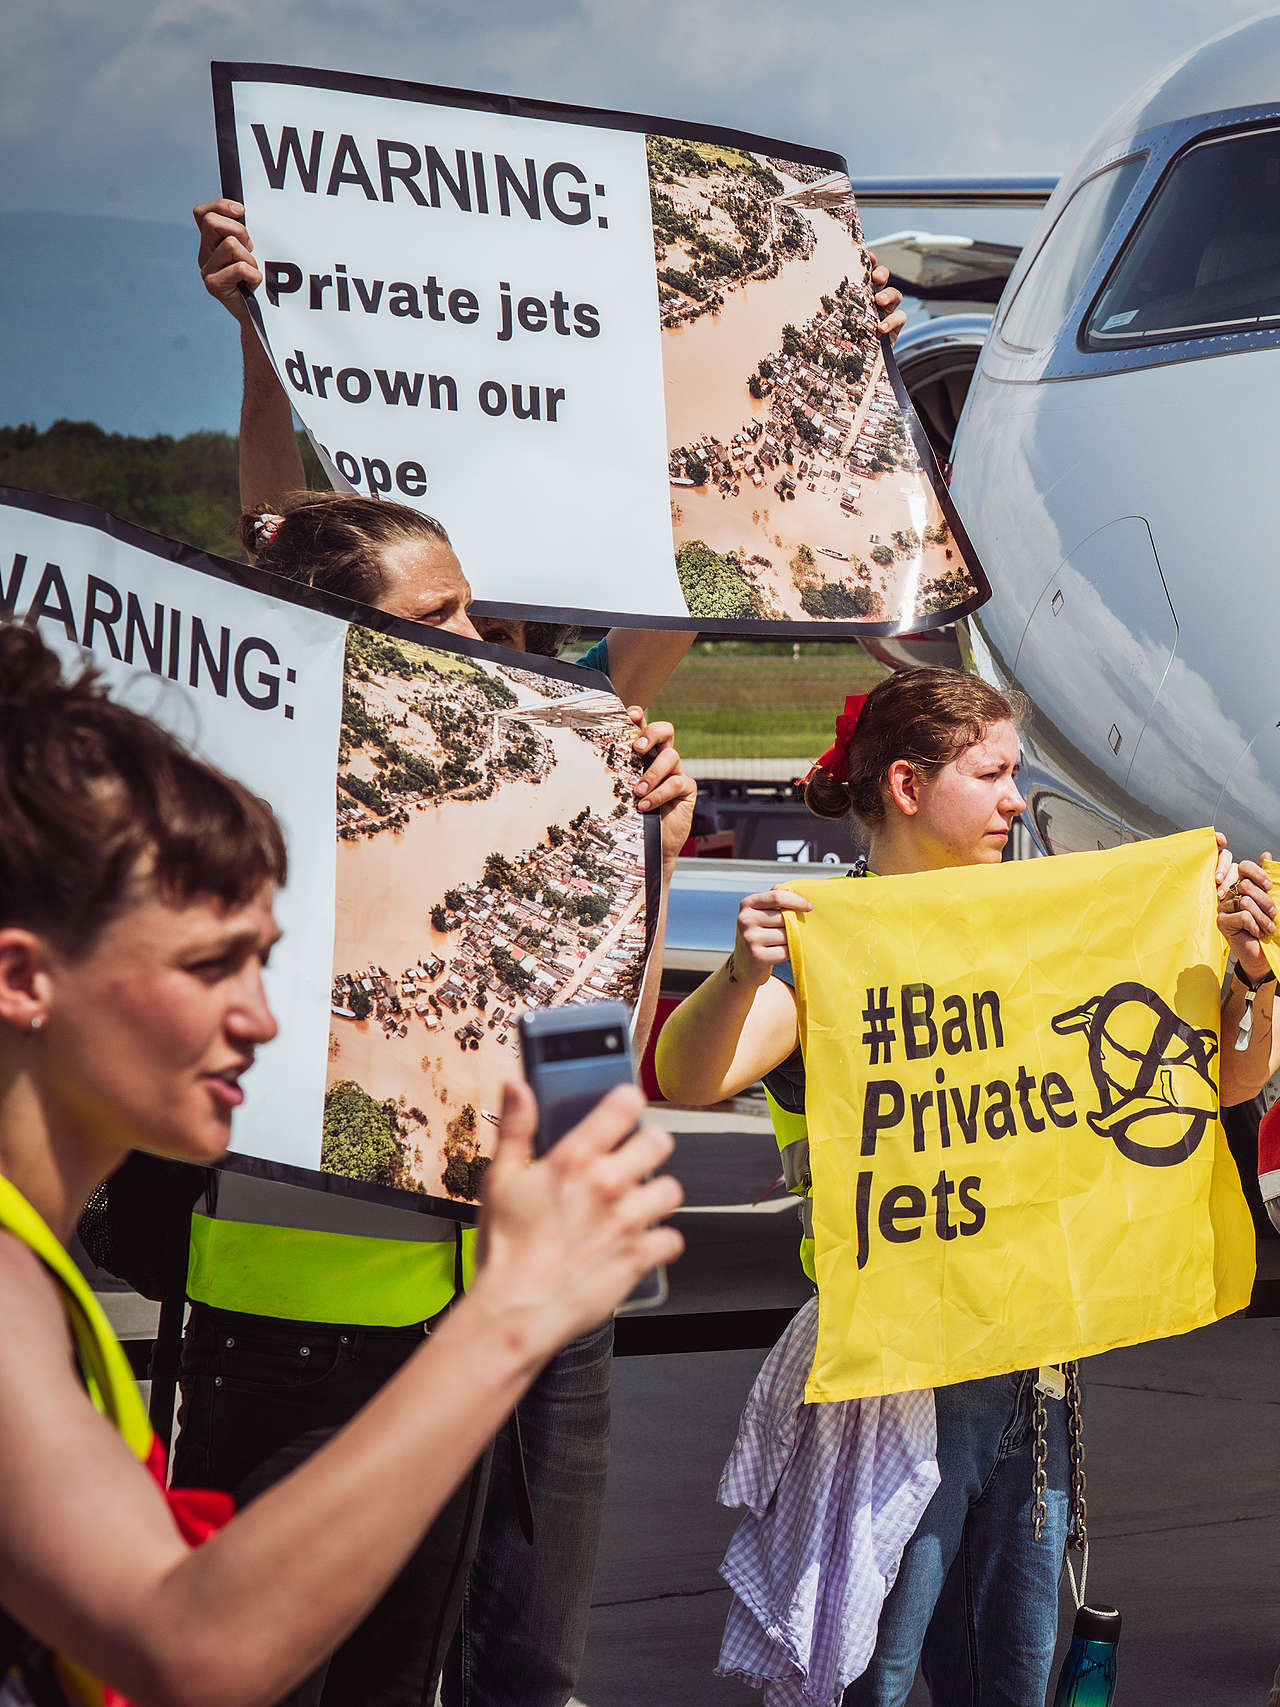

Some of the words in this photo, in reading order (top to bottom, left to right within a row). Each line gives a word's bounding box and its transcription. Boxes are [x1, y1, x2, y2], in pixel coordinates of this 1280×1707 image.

[250, 123, 609, 230] WARNING:
[264, 261, 480, 325] Private
[497, 281, 601, 342] jets
[284, 349, 458, 412] drown
[478, 379, 566, 422] our
[318, 442, 428, 500] ope
[862, 982, 1004, 1065] #Ban
[860, 1065, 1078, 1156] Private
[856, 1170, 986, 1270] Jets
